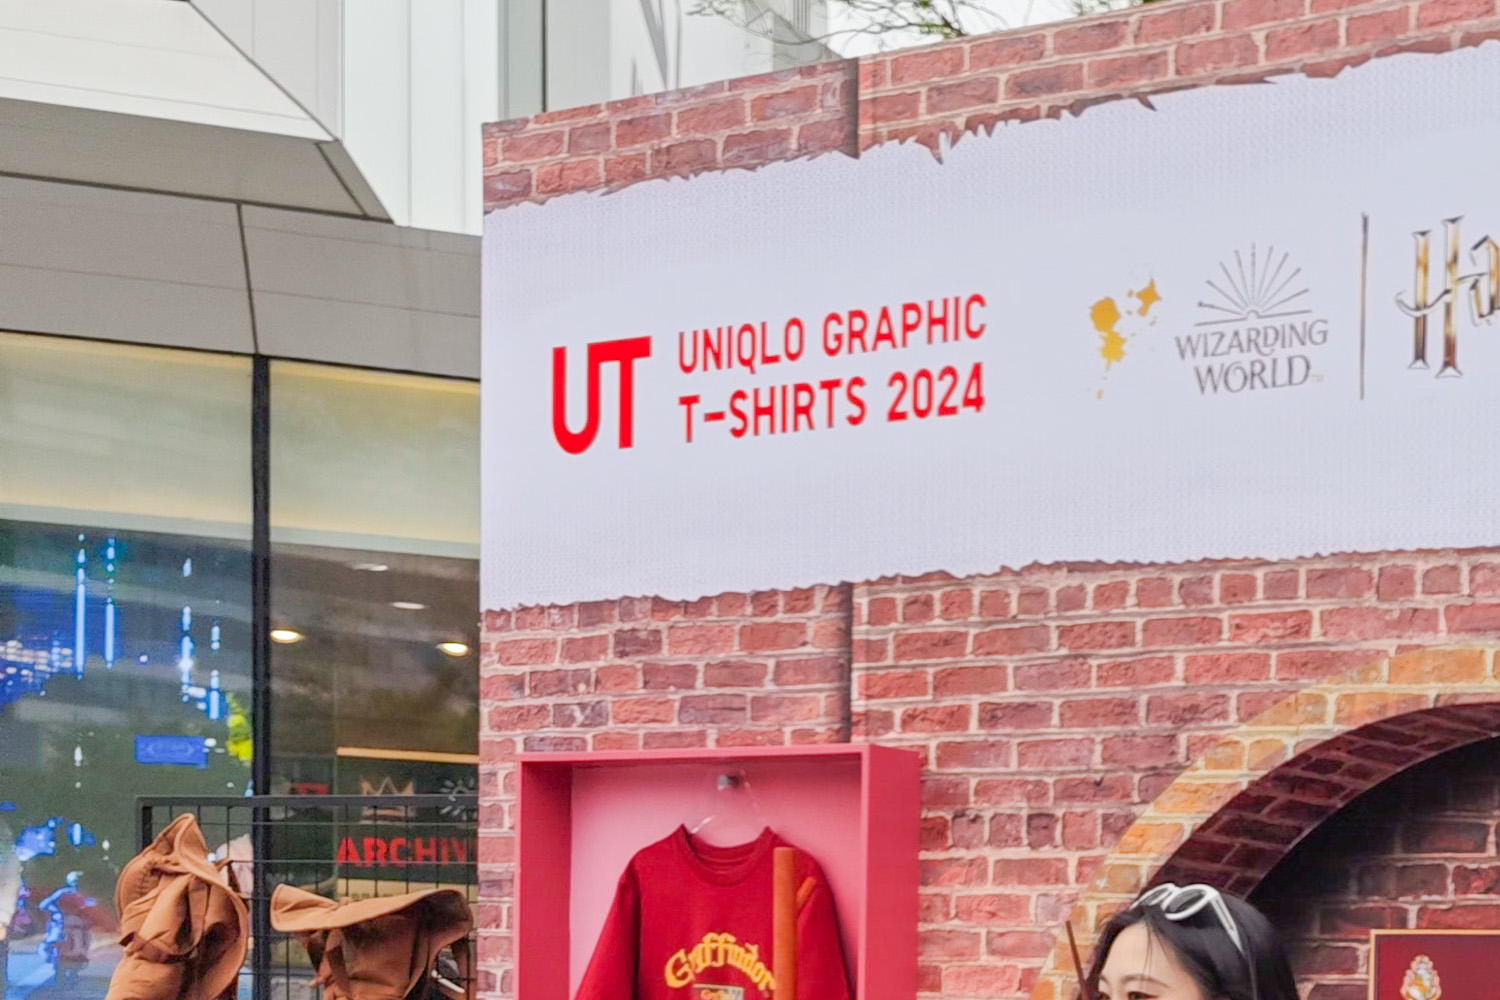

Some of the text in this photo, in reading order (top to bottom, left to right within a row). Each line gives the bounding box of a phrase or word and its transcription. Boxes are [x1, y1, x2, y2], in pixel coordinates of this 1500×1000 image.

[678, 294, 987, 374] UNIQLO GRAPHIC
[1174, 318, 1329, 361] WIZARDING
[552, 336, 652, 455] UT
[678, 362, 985, 443] T-SHIRTS 2024
[1194, 354, 1312, 396] WORLD
[337, 836, 478, 868] ARCHIV
